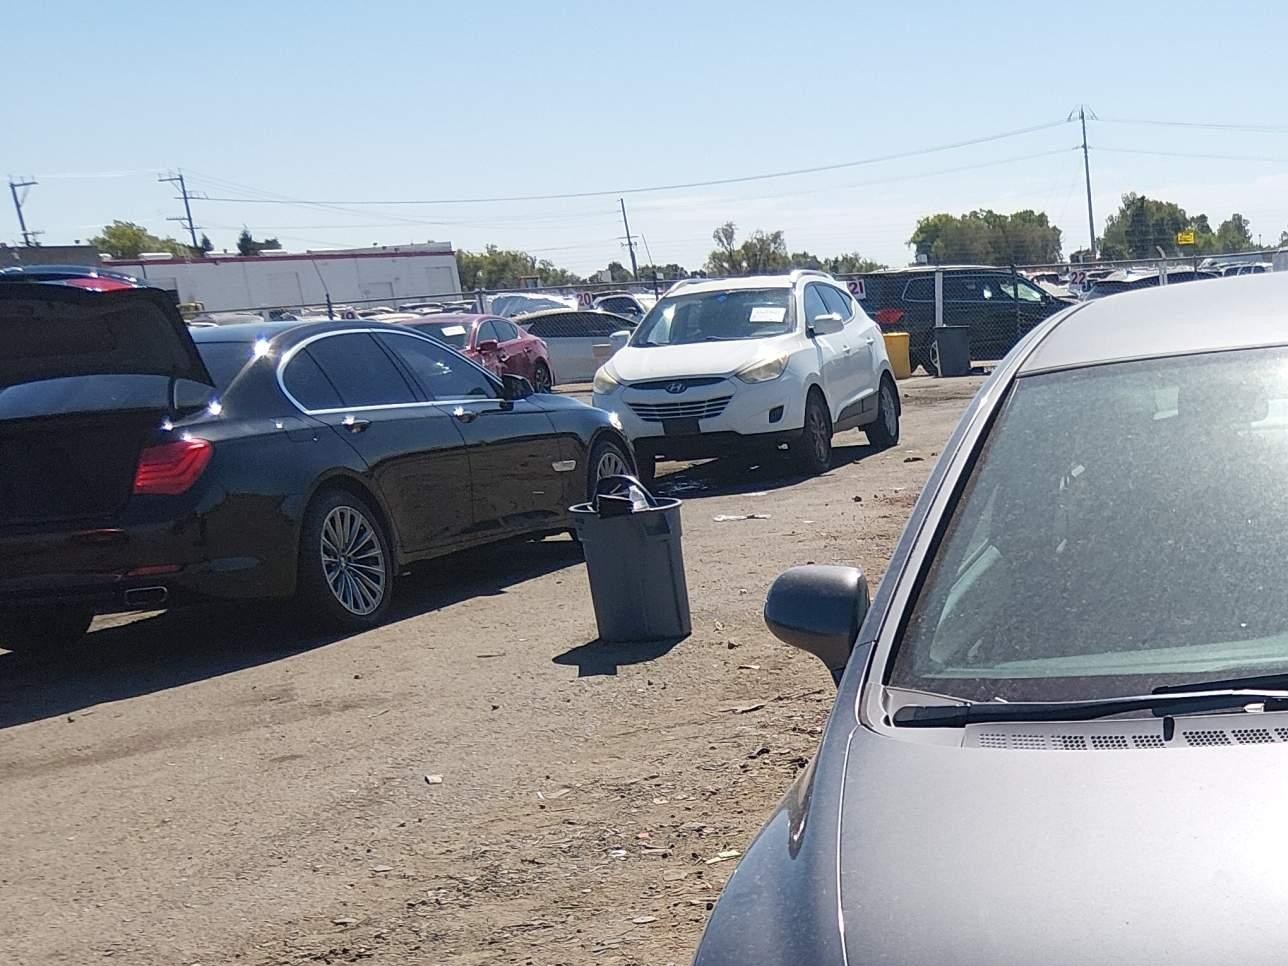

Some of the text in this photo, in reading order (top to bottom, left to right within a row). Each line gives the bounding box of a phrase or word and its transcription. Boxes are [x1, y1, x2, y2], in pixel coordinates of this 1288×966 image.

[1071, 271, 1086, 285] 22
[849, 281, 864, 295] 21
[577, 293, 592, 307] 20
